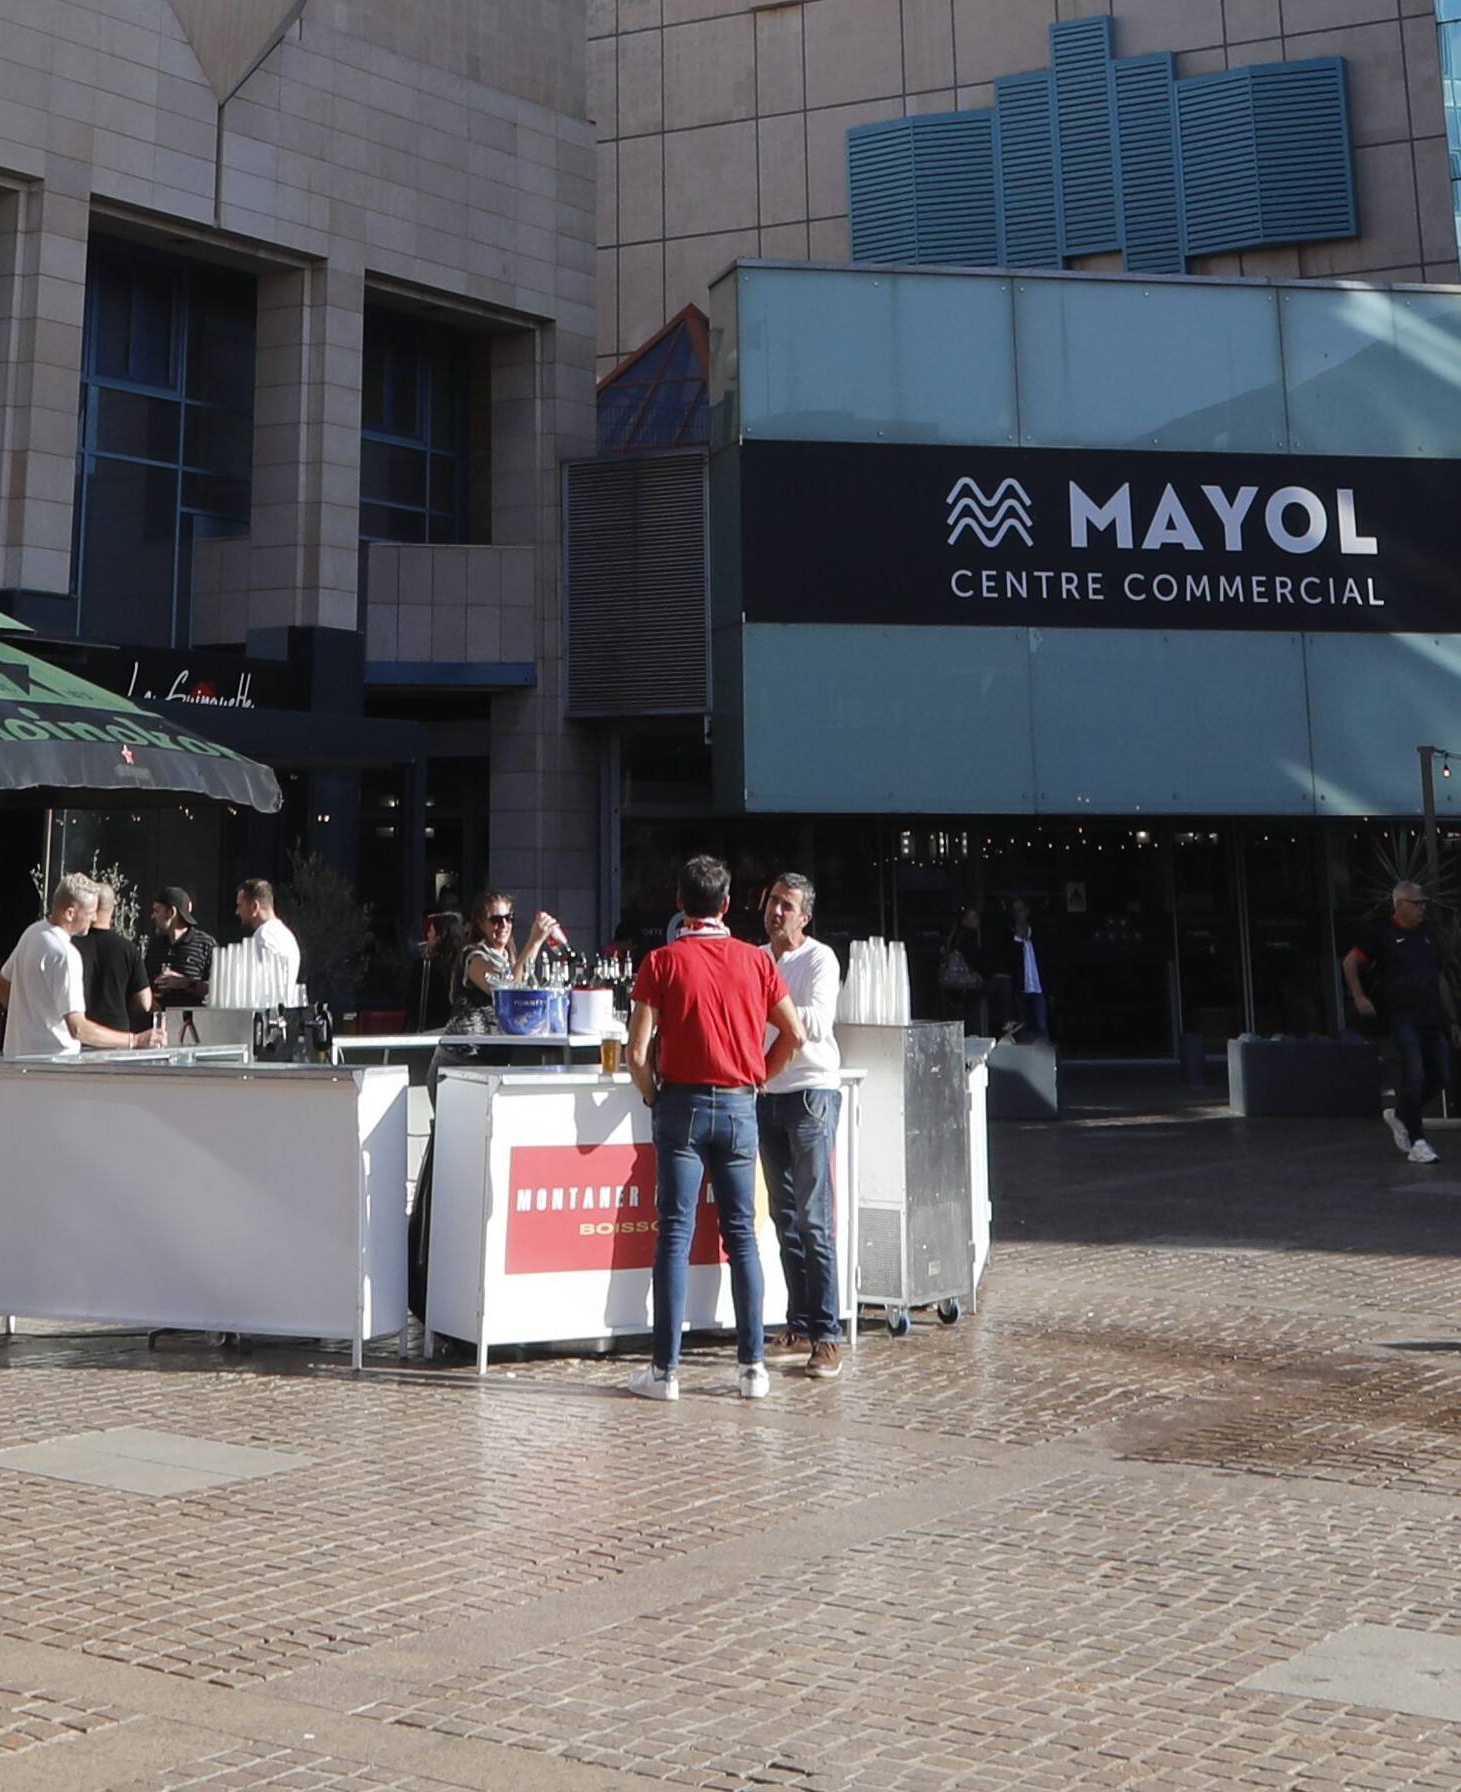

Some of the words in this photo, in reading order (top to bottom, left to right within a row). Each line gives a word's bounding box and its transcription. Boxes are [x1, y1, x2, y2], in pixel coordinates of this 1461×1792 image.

[1069, 480, 1378, 554] MAYOL
[950, 569, 1105, 600] CENTRE
[1123, 573, 1385, 606] COMMERCIAL
[516, 1185, 639, 1212] MONTANER
[579, 1220, 659, 1236] BOISSO
